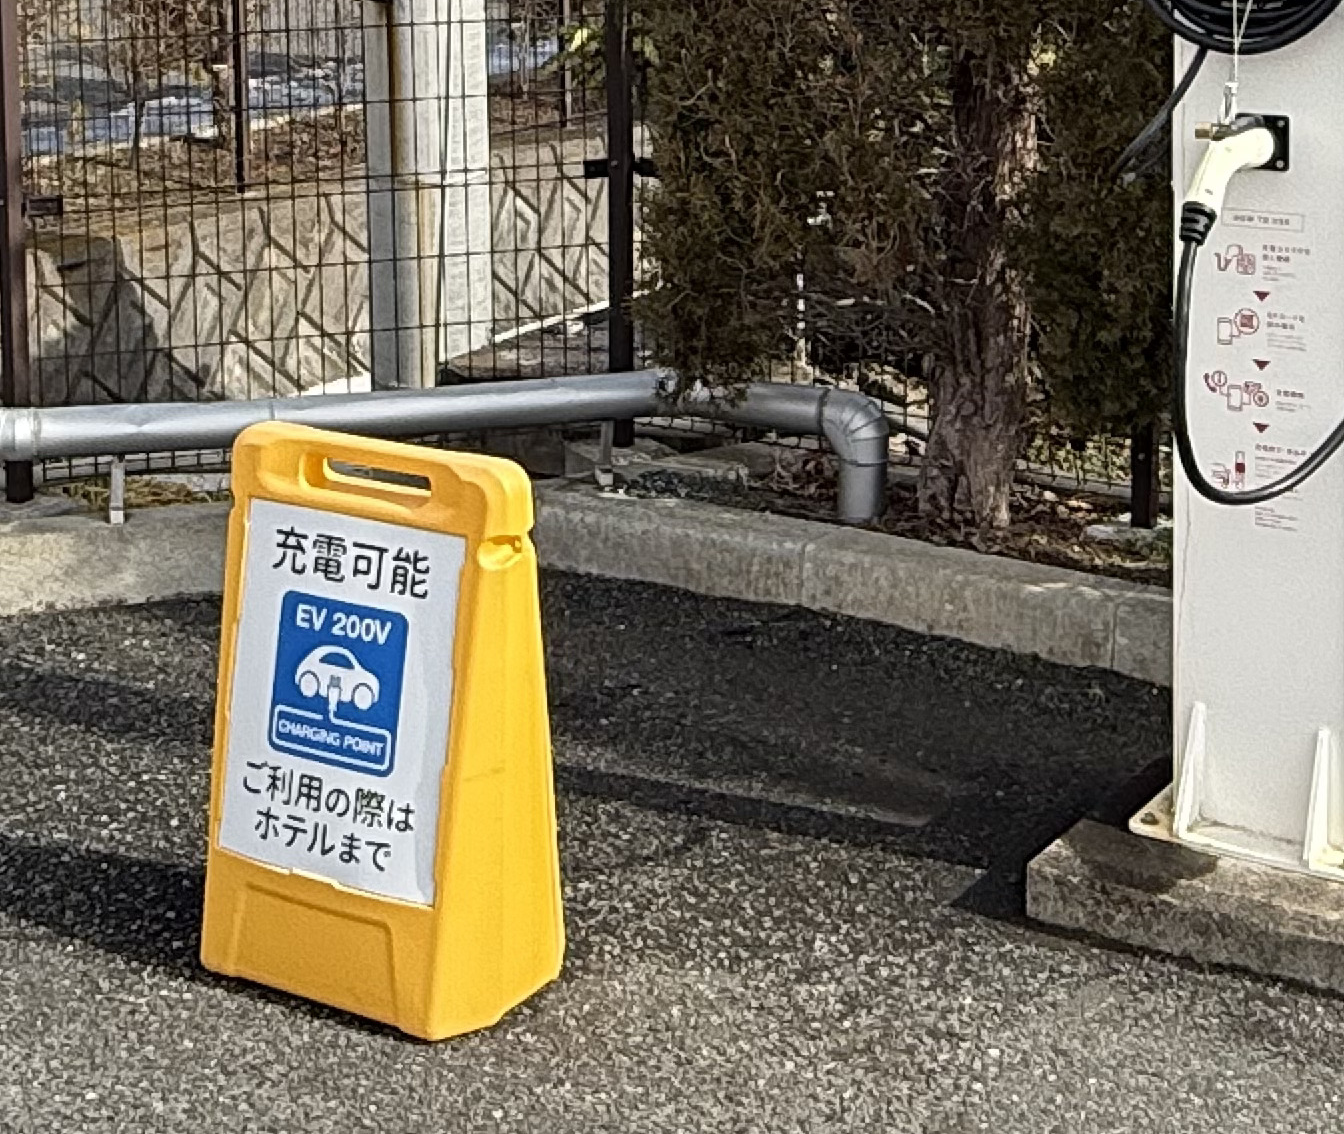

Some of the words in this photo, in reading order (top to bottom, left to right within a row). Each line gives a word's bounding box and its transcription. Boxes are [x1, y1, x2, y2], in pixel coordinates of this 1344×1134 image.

[272, 526, 430, 600] 充電可能
[296, 603, 327, 631] EV
[331, 612, 392, 645] 200V
[278, 719, 341, 747] CHARGING
[342, 735, 385, 757] POINT
[242, 760, 415, 833] ご利用の際は
[255, 806, 392, 872] ホテルまで
